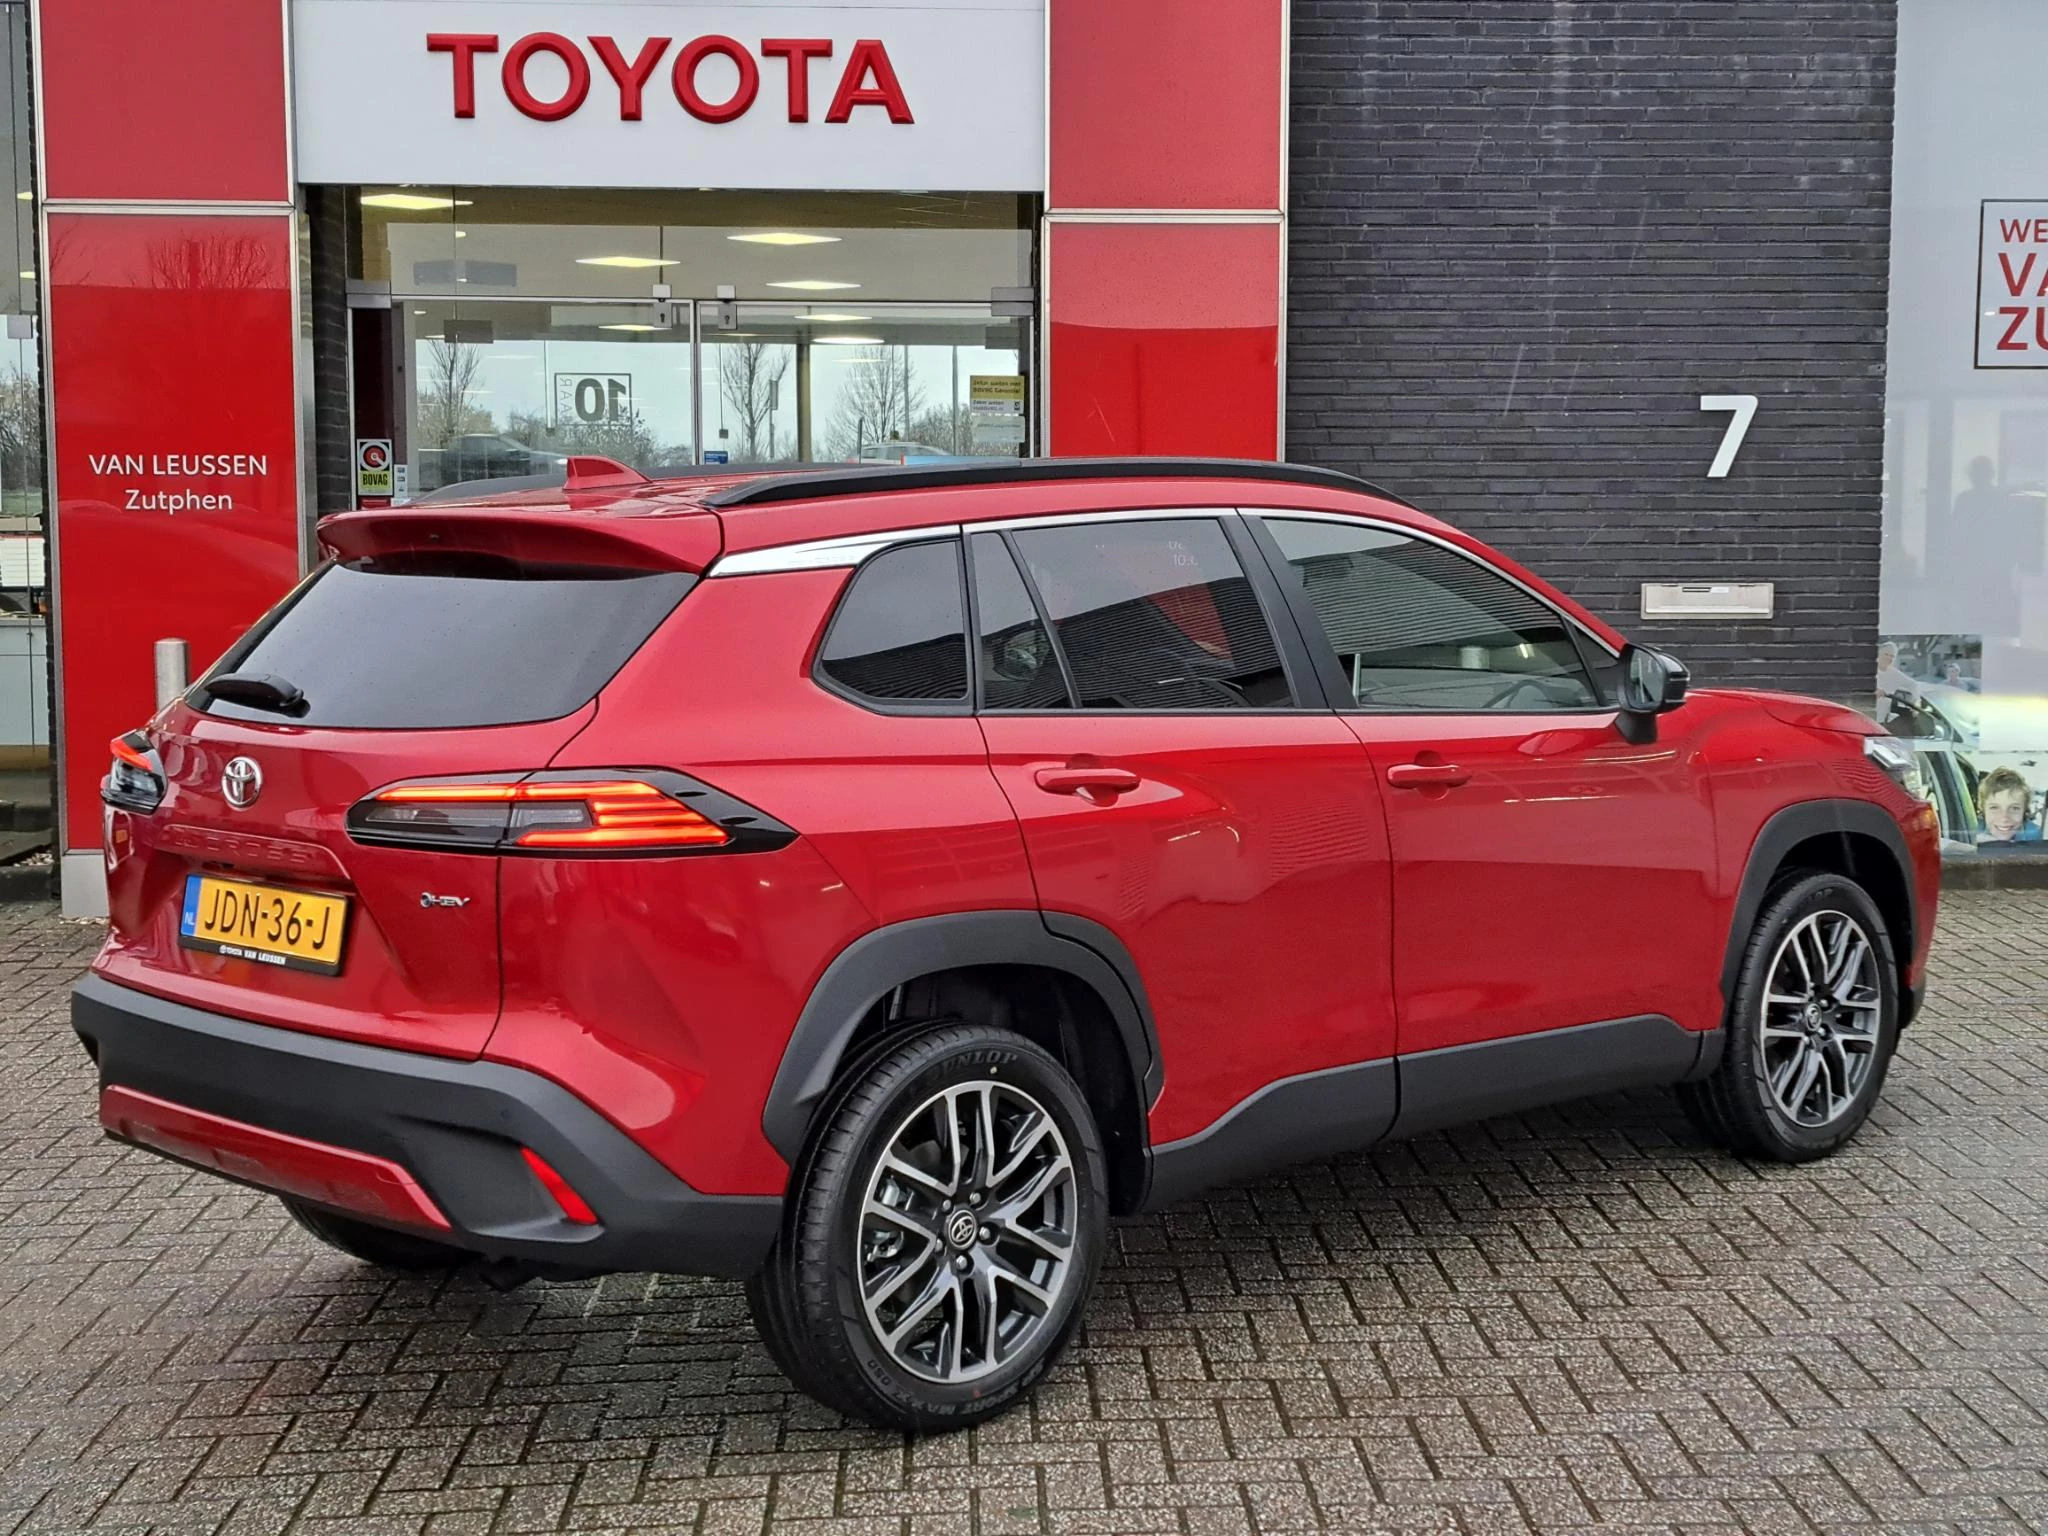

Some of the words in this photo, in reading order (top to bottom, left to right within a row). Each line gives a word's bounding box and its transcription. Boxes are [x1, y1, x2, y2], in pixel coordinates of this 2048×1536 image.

[426, 32, 915, 124] TOYOTA
[1700, 394, 1759, 478] 7
[88, 454, 144, 476] VAN
[152, 454, 267, 476] LEUSSEN
[362, 473, 389, 487] BOVAG
[124, 488, 233, 516] Zutphen
[184, 911, 195, 926] NL
[204, 888, 331, 950] JDN-36-J
